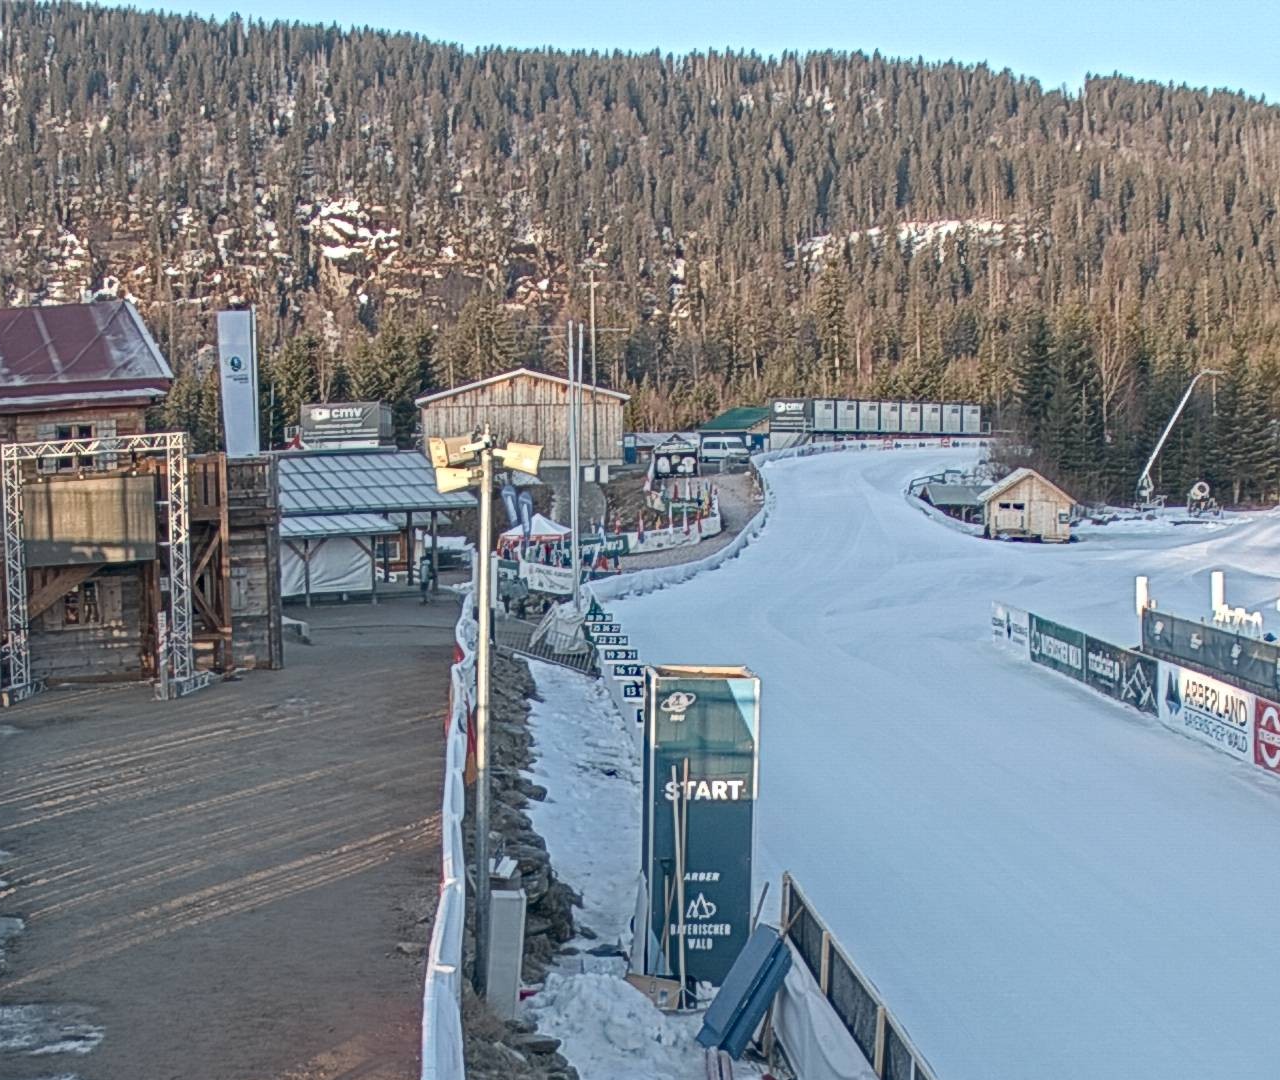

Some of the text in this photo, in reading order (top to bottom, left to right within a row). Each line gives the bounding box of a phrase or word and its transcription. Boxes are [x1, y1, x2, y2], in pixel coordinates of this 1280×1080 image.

[628, 666, 637, 675] 17
[626, 687, 636, 696] 13
[1184, 679, 1248, 727] ARBERLAND
[664, 781, 744, 801] START
[688, 938, 713, 951] WALD
